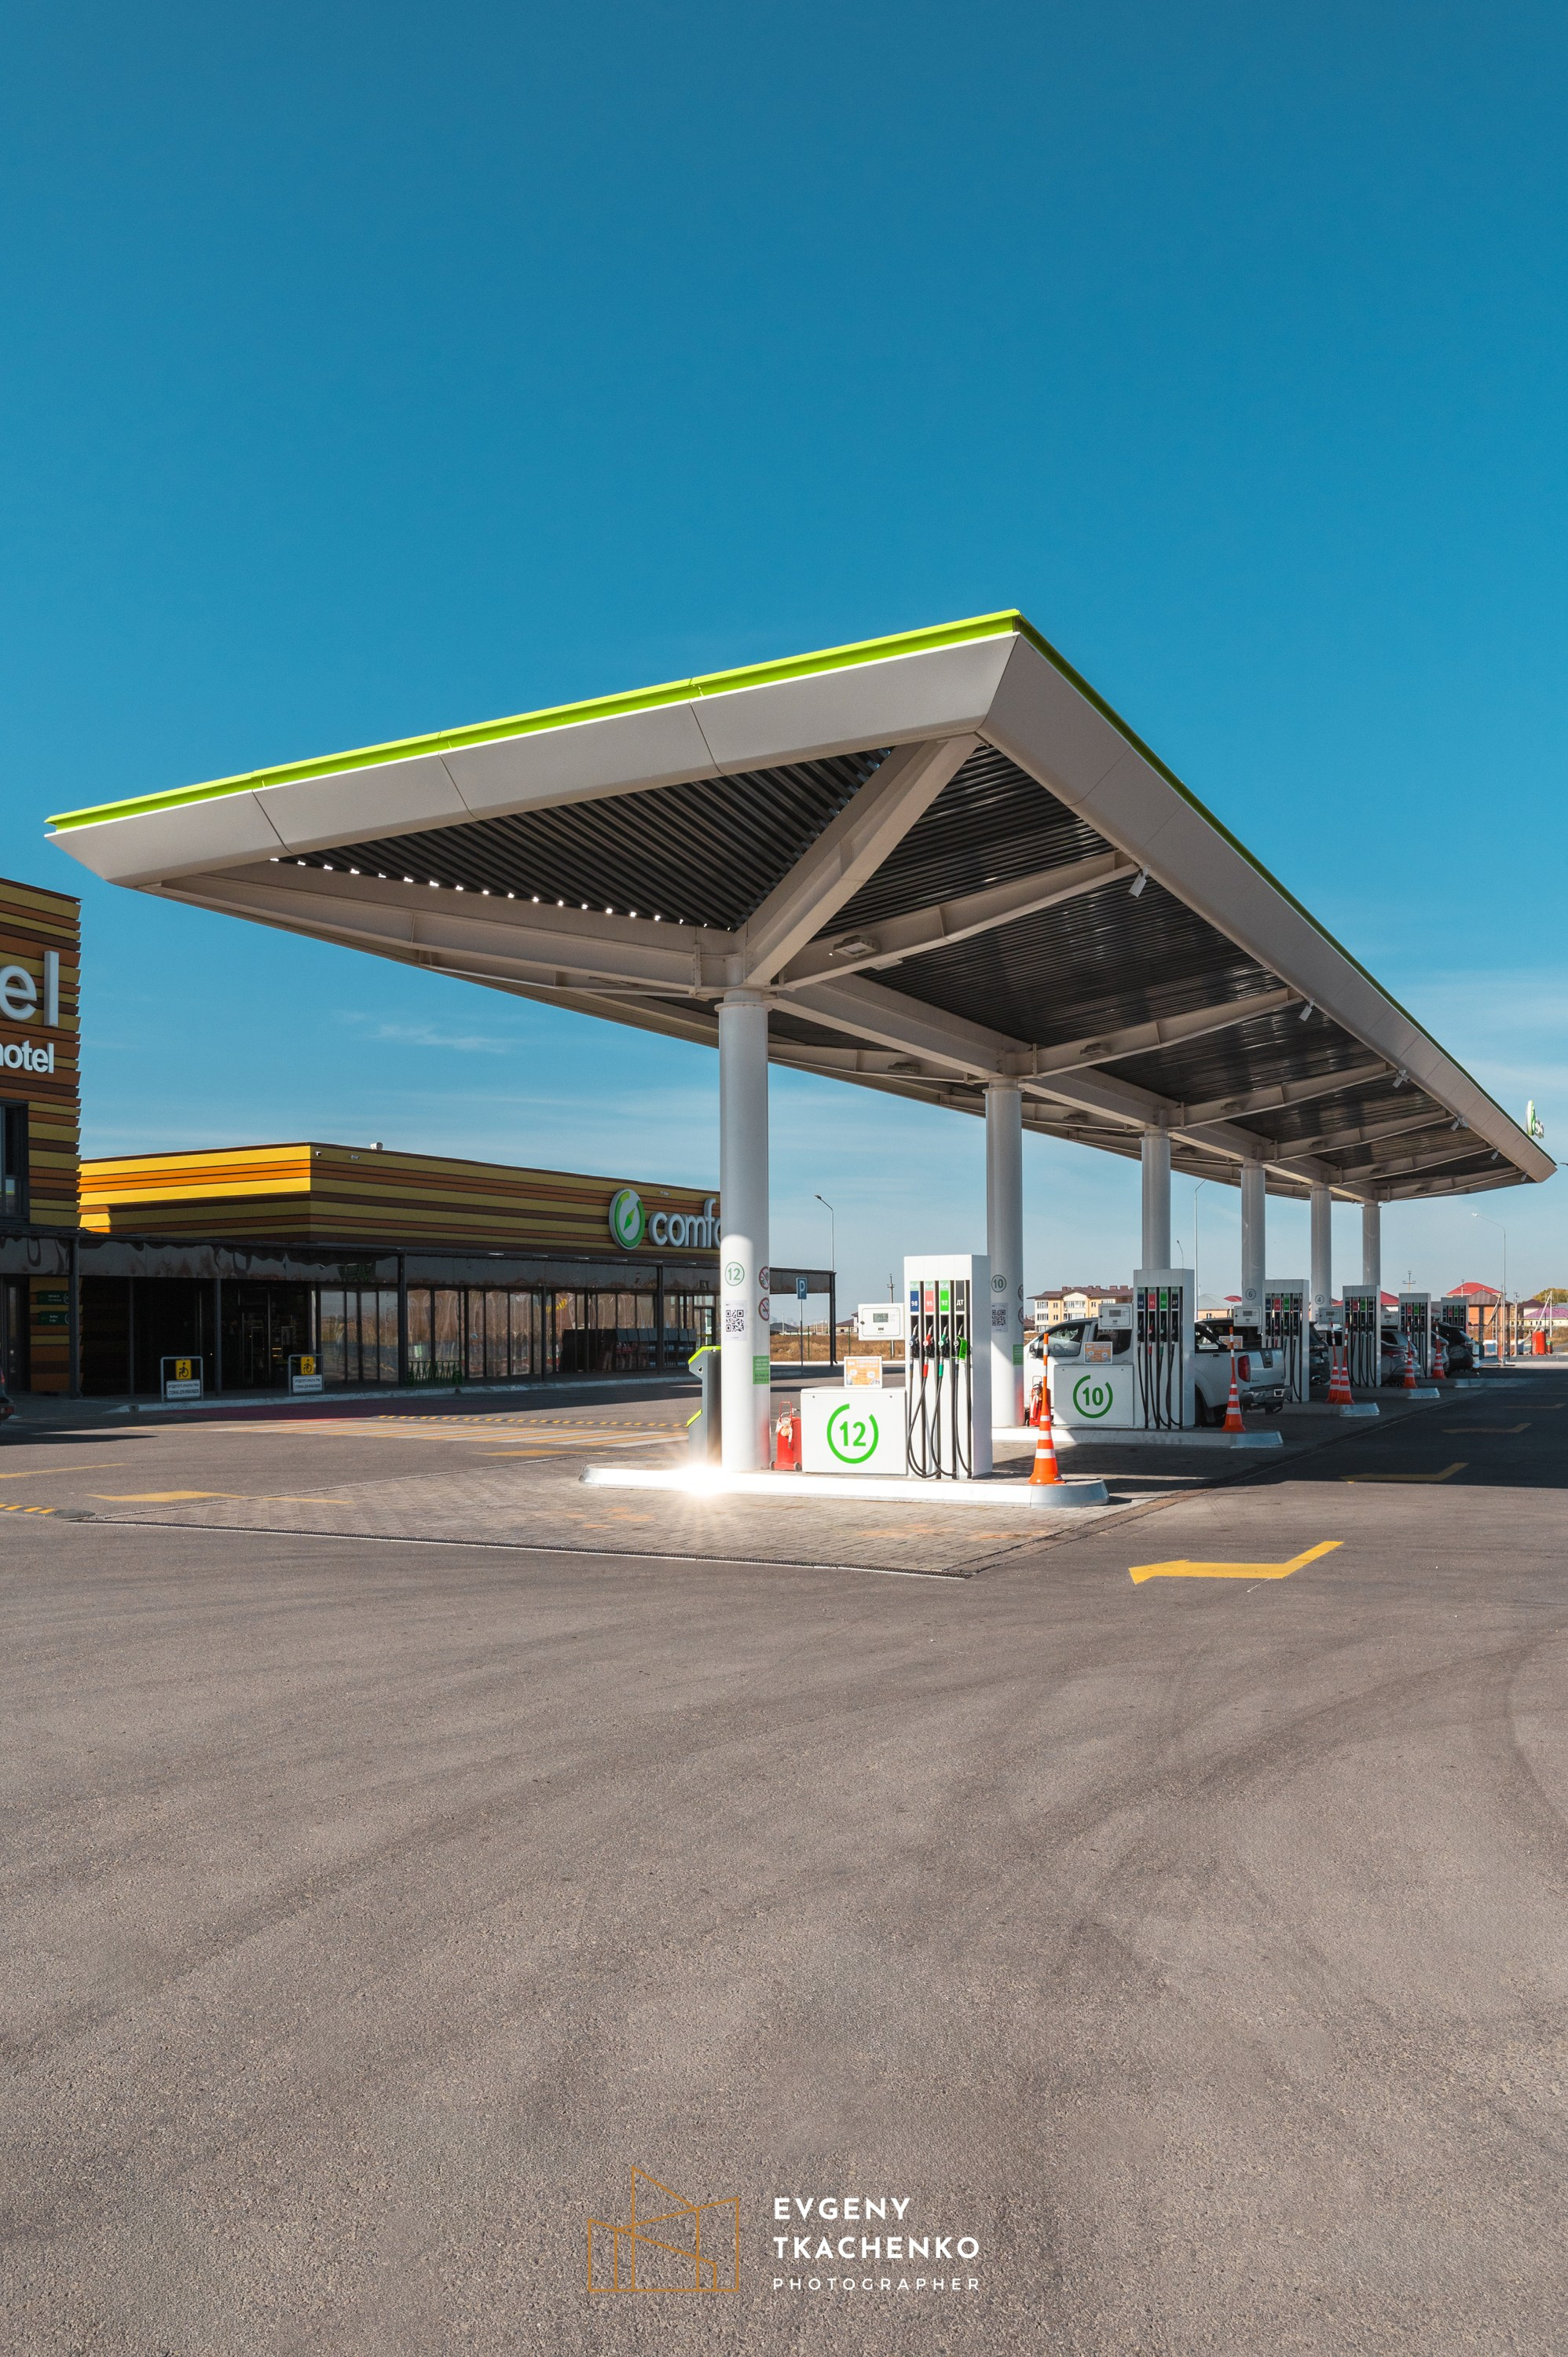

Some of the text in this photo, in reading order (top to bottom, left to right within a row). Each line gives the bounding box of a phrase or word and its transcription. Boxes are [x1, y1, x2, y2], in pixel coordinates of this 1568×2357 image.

[728, 1267, 741, 1281] 12
[994, 1278, 1004, 1288] 10
[799, 1280, 806, 1298] P
[1083, 1387, 1104, 1406] 10
[840, 1420, 866, 1446] 12
